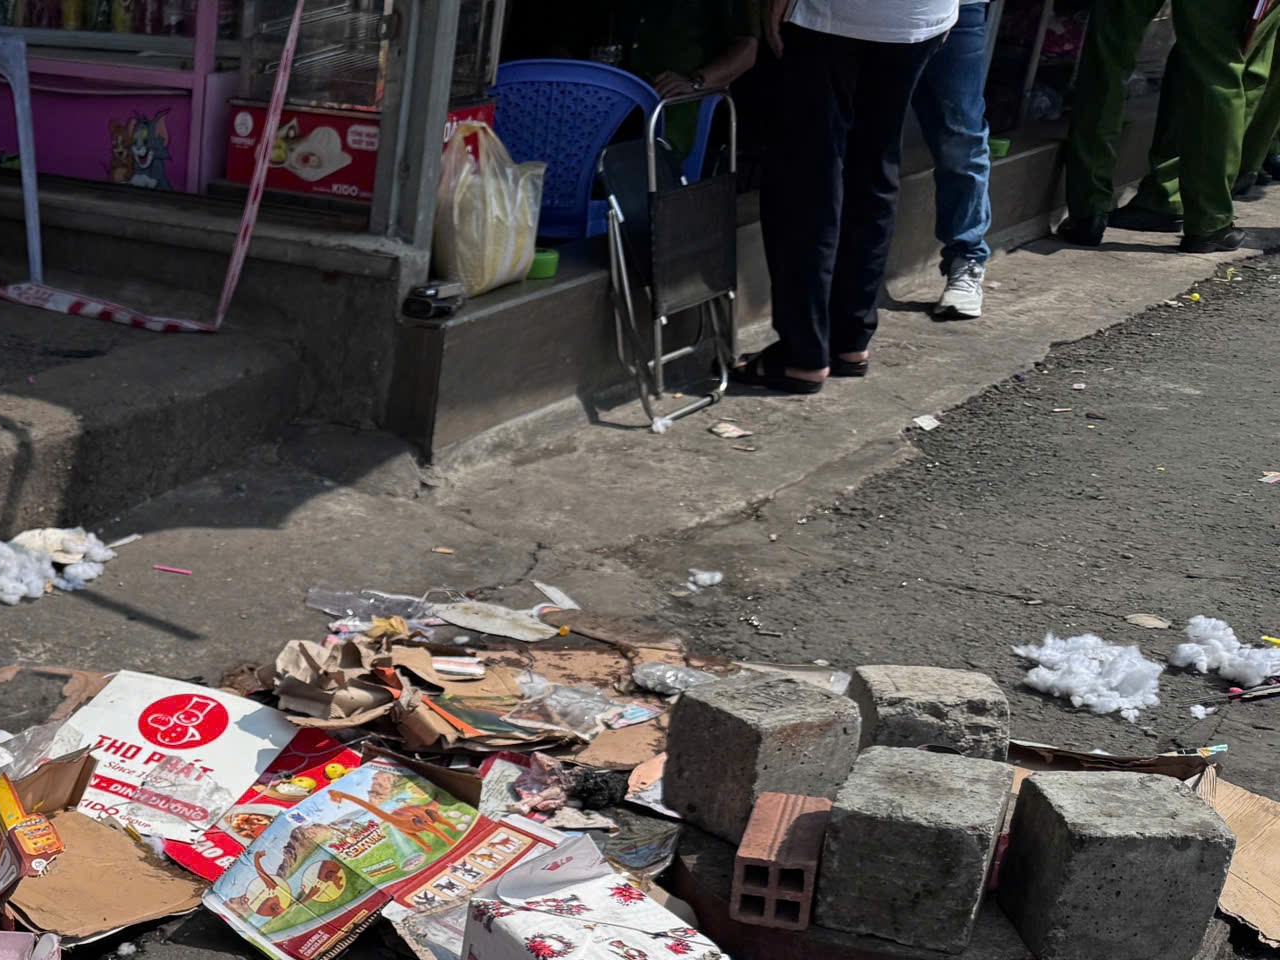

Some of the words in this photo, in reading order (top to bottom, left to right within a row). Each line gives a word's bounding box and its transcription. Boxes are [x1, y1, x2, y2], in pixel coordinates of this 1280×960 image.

[331, 184, 359, 196] KIDO
[95, 735, 143, 762] THỌ
[144, 751, 214, 781] PHÁT
[104, 761, 135, 776] Since
[109, 785, 147, 801] DINH
[120, 814, 151, 828] GROUP
[298, 930, 324, 954] ASSEMBLE
[303, 934, 331, 957] DINOSAUR
